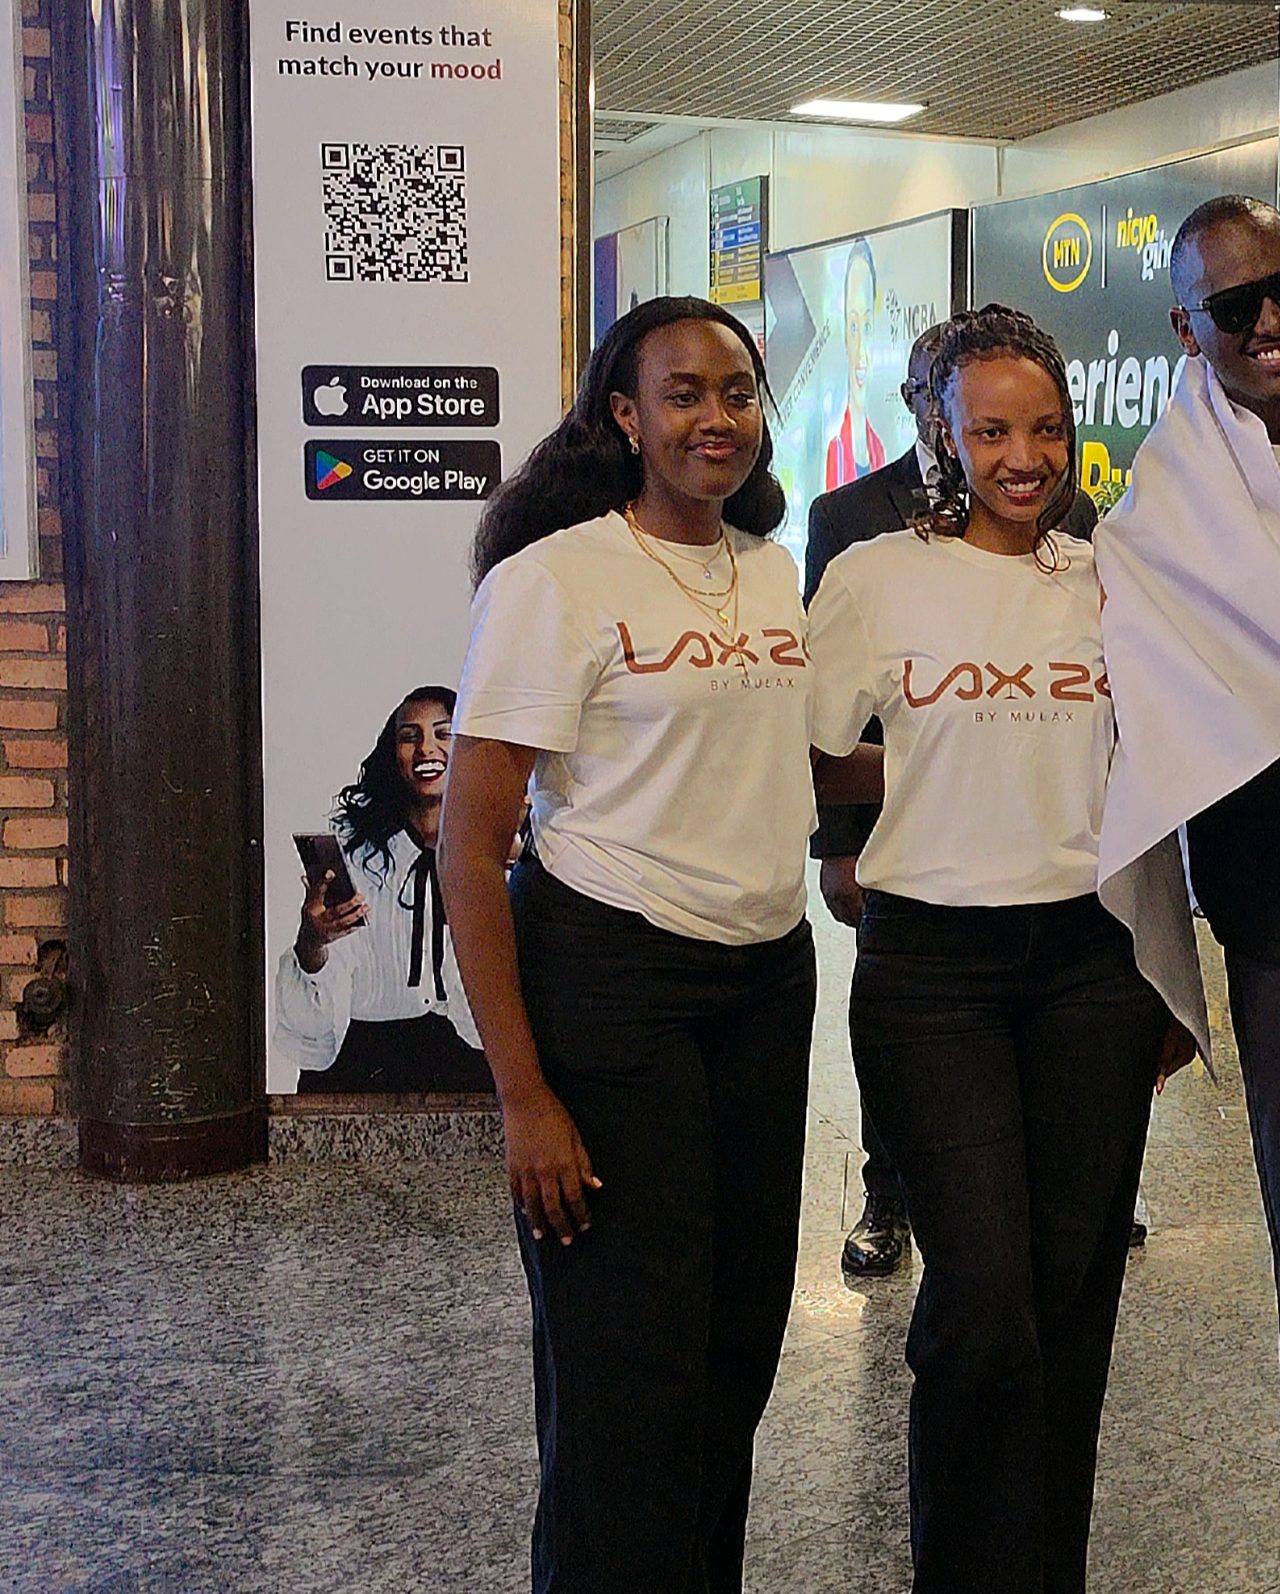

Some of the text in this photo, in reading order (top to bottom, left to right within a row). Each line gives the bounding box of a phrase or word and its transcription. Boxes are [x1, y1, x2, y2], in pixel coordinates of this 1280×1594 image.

[286, 21, 493, 47] Find events that
[278, 55, 502, 81] match your mood
[1116, 207, 1158, 256] nicyo
[1054, 236, 1080, 269] MTN
[1141, 229, 1177, 281] gih
[361, 376, 479, 389] Download on the
[361, 393, 486, 420] App Store
[363, 449, 440, 463] GET IT ON
[363, 469, 488, 495] Google Play
[711, 678, 795, 691] BY MULAX
[975, 712, 1075, 723] BY MULAX
